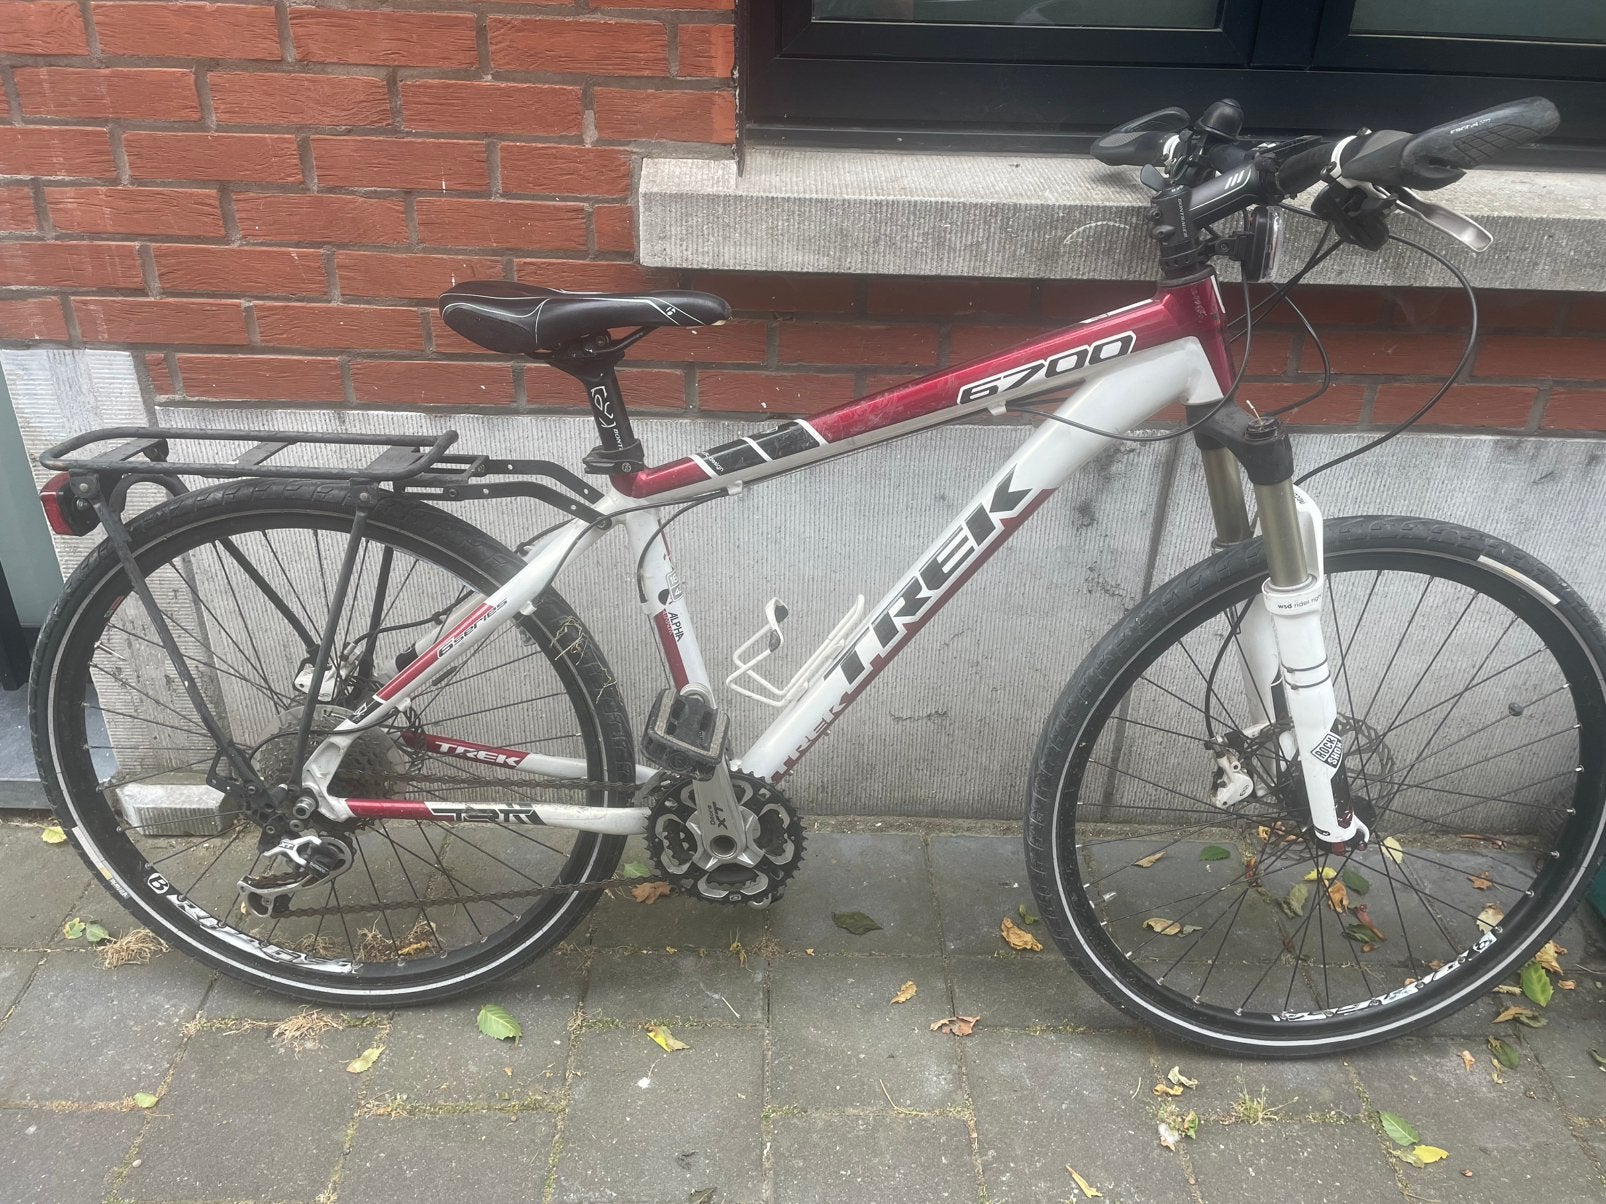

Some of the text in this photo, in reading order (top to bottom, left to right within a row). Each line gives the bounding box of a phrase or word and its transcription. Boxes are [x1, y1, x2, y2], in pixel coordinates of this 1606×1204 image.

[957, 331, 1137, 405] 6700
[612, 428, 624, 451] BONT
[823, 463, 1033, 686] TREK
[1294, 599, 1310, 609] rider
[437, 599, 508, 658] 6series
[668, 611, 684, 642] ALPHA
[434, 741, 521, 768] TREK
[1314, 736, 1337, 760] ROCK
[712, 801, 728, 830] XT
[279, 841, 295, 850] XT
